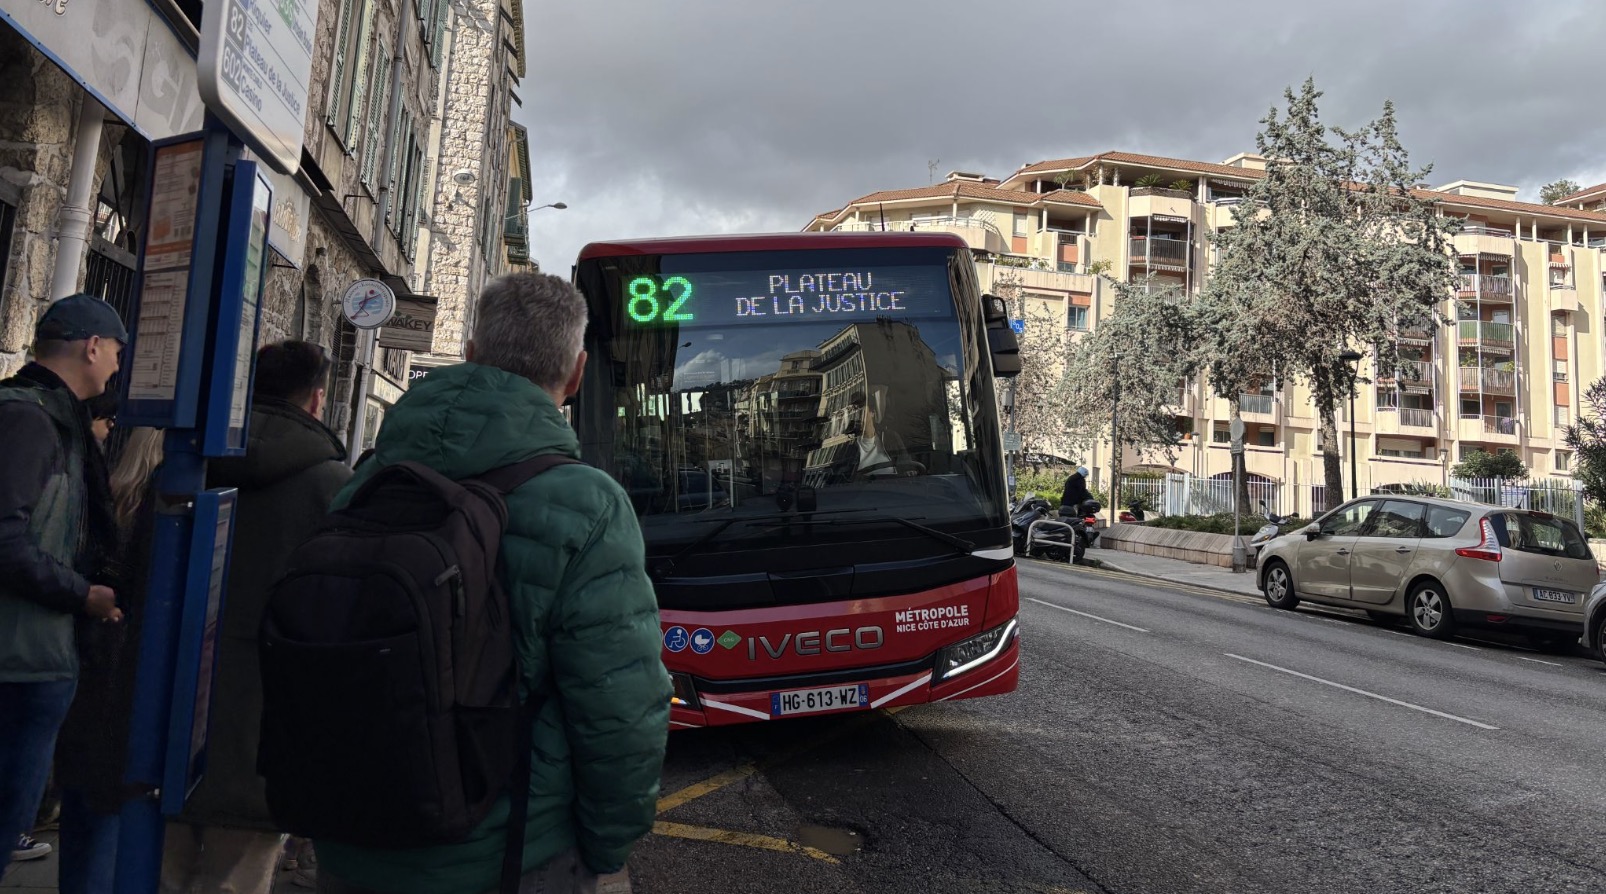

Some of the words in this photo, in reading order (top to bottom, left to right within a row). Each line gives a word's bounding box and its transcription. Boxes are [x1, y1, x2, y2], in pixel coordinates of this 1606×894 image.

[223, 48, 240, 85] 602
[231, 6, 243, 41] 82
[244, 33, 268, 75] Plateau
[268, 64, 276, 85] de
[276, 73, 282, 92] la
[281, 82, 300, 115] Justice
[240, 75, 262, 112] Casino
[769, 272, 872, 293] PLATEAU
[627, 276, 694, 322] 82
[736, 296, 766, 316] DE
[773, 296, 803, 315] LA
[811, 291, 906, 313] JUSTICE
[895, 605, 969, 623] MÉTROPOLE
[896, 623, 916, 633] NICE
[918, 620, 940, 630] CÔTE
[940, 617, 970, 628] D'AZUR
[748, 626, 884, 660] IVECO
[782, 688, 857, 711] HG-613-WZ
[860, 695, 868, 703] 06
